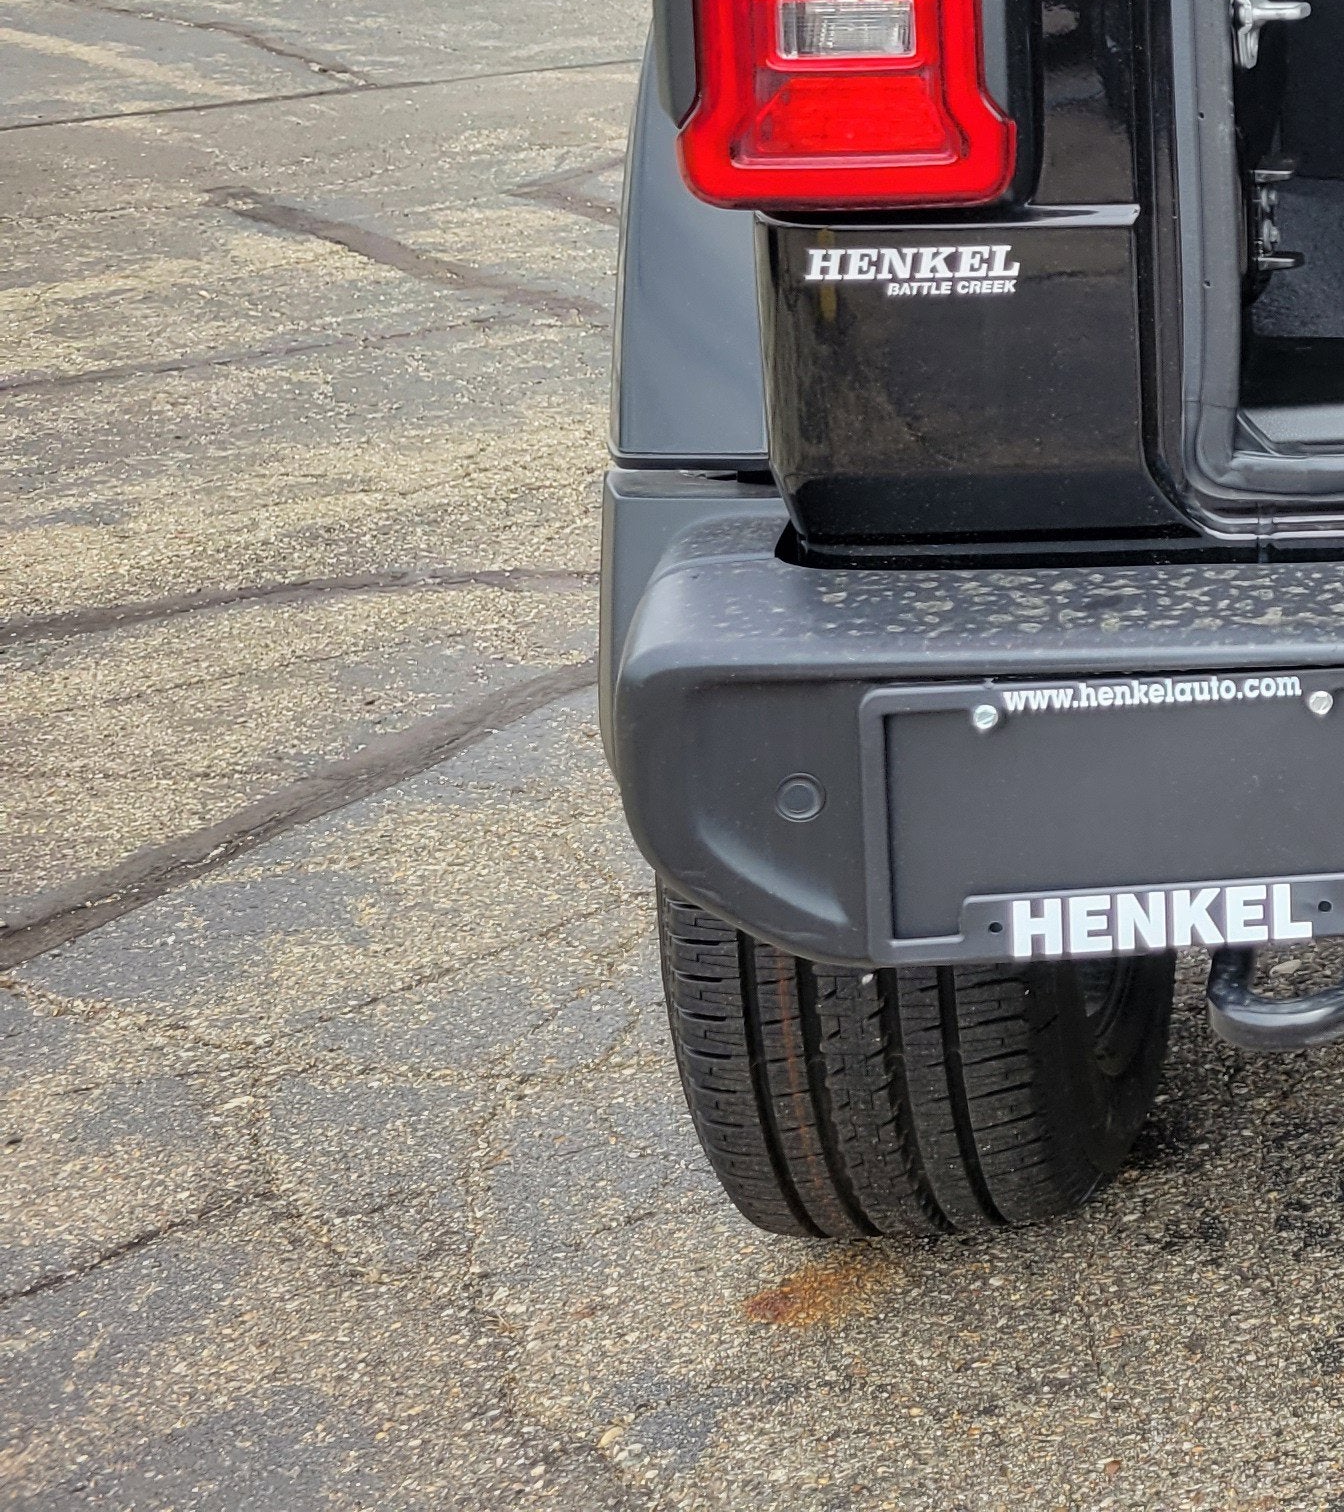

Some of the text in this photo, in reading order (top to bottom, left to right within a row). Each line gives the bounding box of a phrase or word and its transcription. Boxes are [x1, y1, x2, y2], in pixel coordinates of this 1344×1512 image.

[804, 244, 1021, 281] HENKEL
[887, 279, 1018, 297] BATTLE CREEK
[1002, 674, 1303, 712] www.henkelauto.com
[1012, 883, 1313, 958] HENKEL
